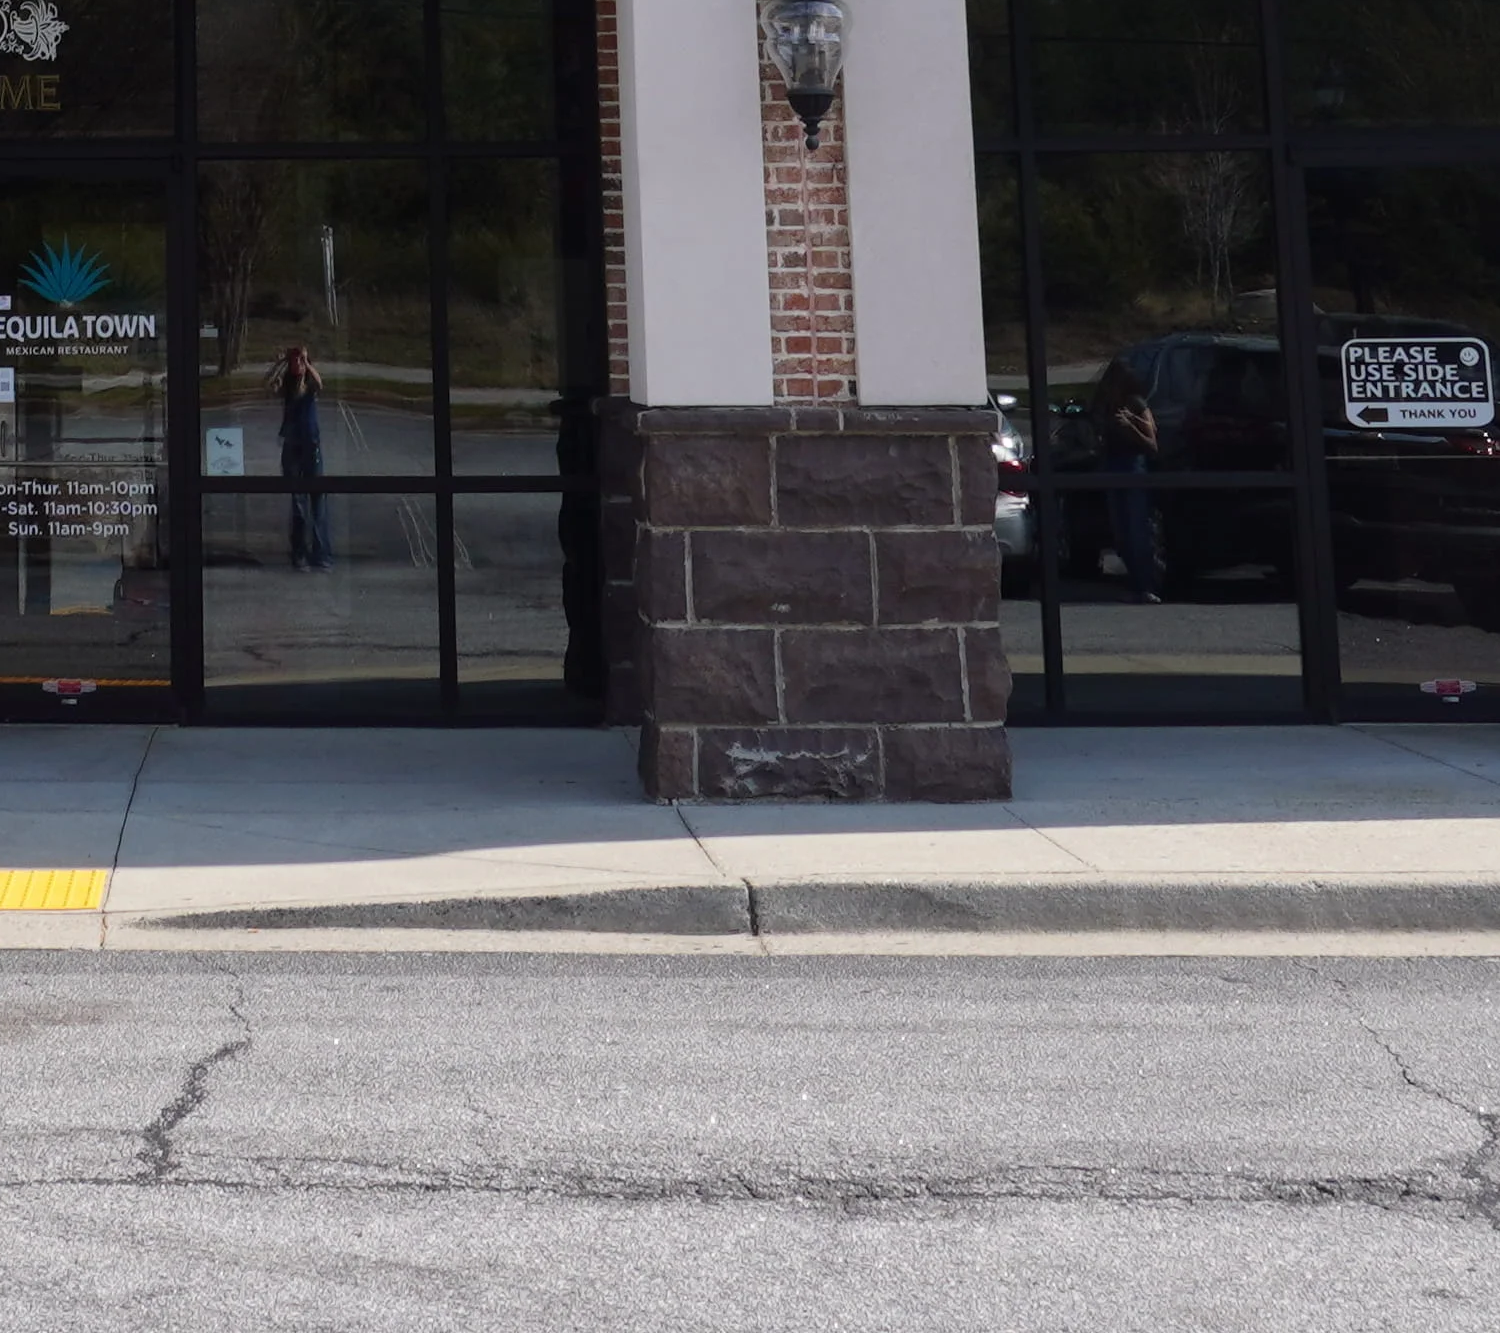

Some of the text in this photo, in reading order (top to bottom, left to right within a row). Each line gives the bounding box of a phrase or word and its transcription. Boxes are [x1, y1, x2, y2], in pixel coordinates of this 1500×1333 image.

[82, 314, 156, 339] TOWN
[6, 345, 129, 356] MEXICAN RESTAURANT
[1349, 346, 1439, 364] PLEASE
[1350, 364, 1460, 381] USE SIDE
[1351, 382, 1486, 398] ENTRANCE
[1400, 408, 1477, 420] THANK YOU
[66, 481, 155, 497] 11am-10pm
[43, 501, 158, 518] 11am-10:30pm
[8, 521, 130, 537] Sun. 11am-9pm
